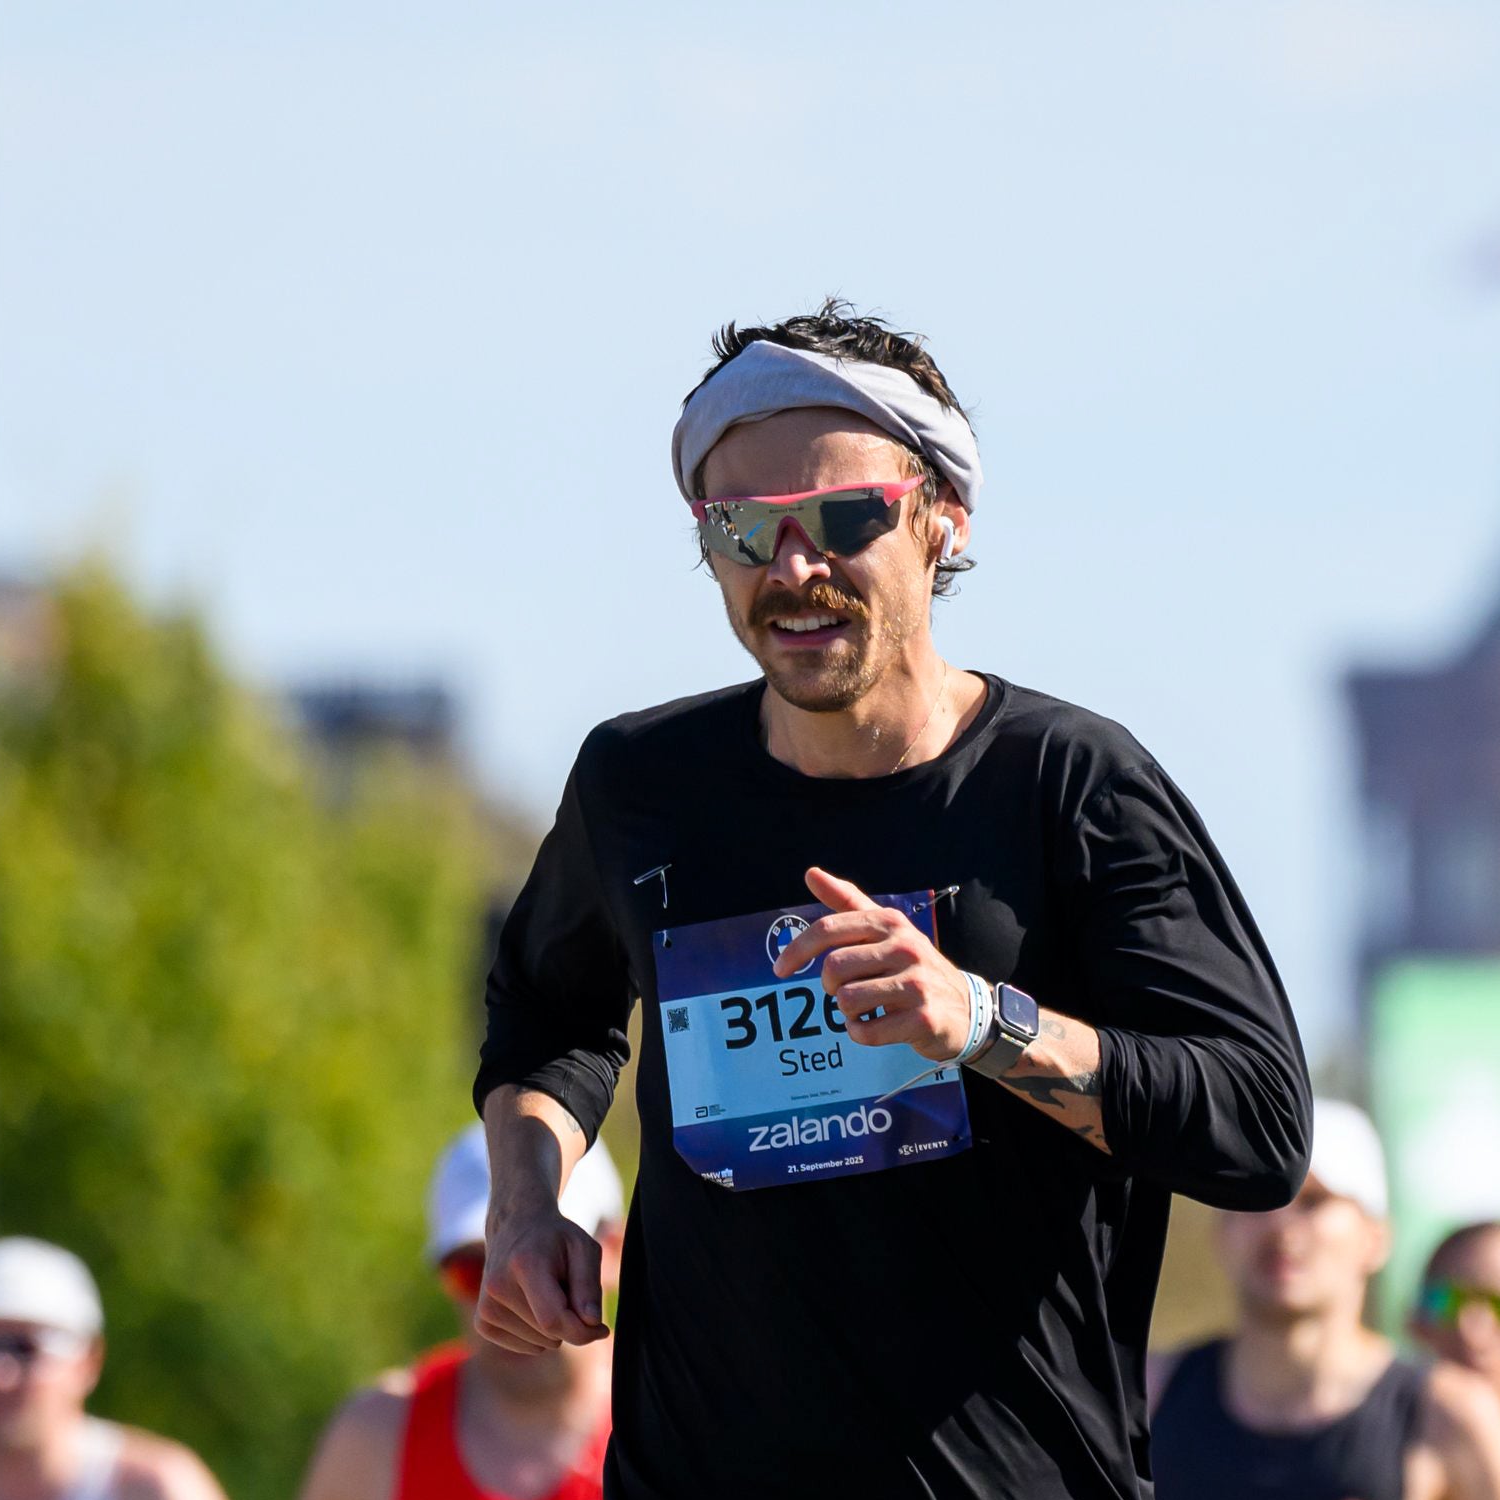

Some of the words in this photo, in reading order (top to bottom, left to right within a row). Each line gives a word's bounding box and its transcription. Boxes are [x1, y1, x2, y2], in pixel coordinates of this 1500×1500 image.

[779, 1041, 844, 1077] Sted
[748, 1105, 893, 1153] zalando
[787, 1164, 799, 1174] 21.
[800, 1159, 844, 1174] September
[844, 1155, 864, 1167] 2025
